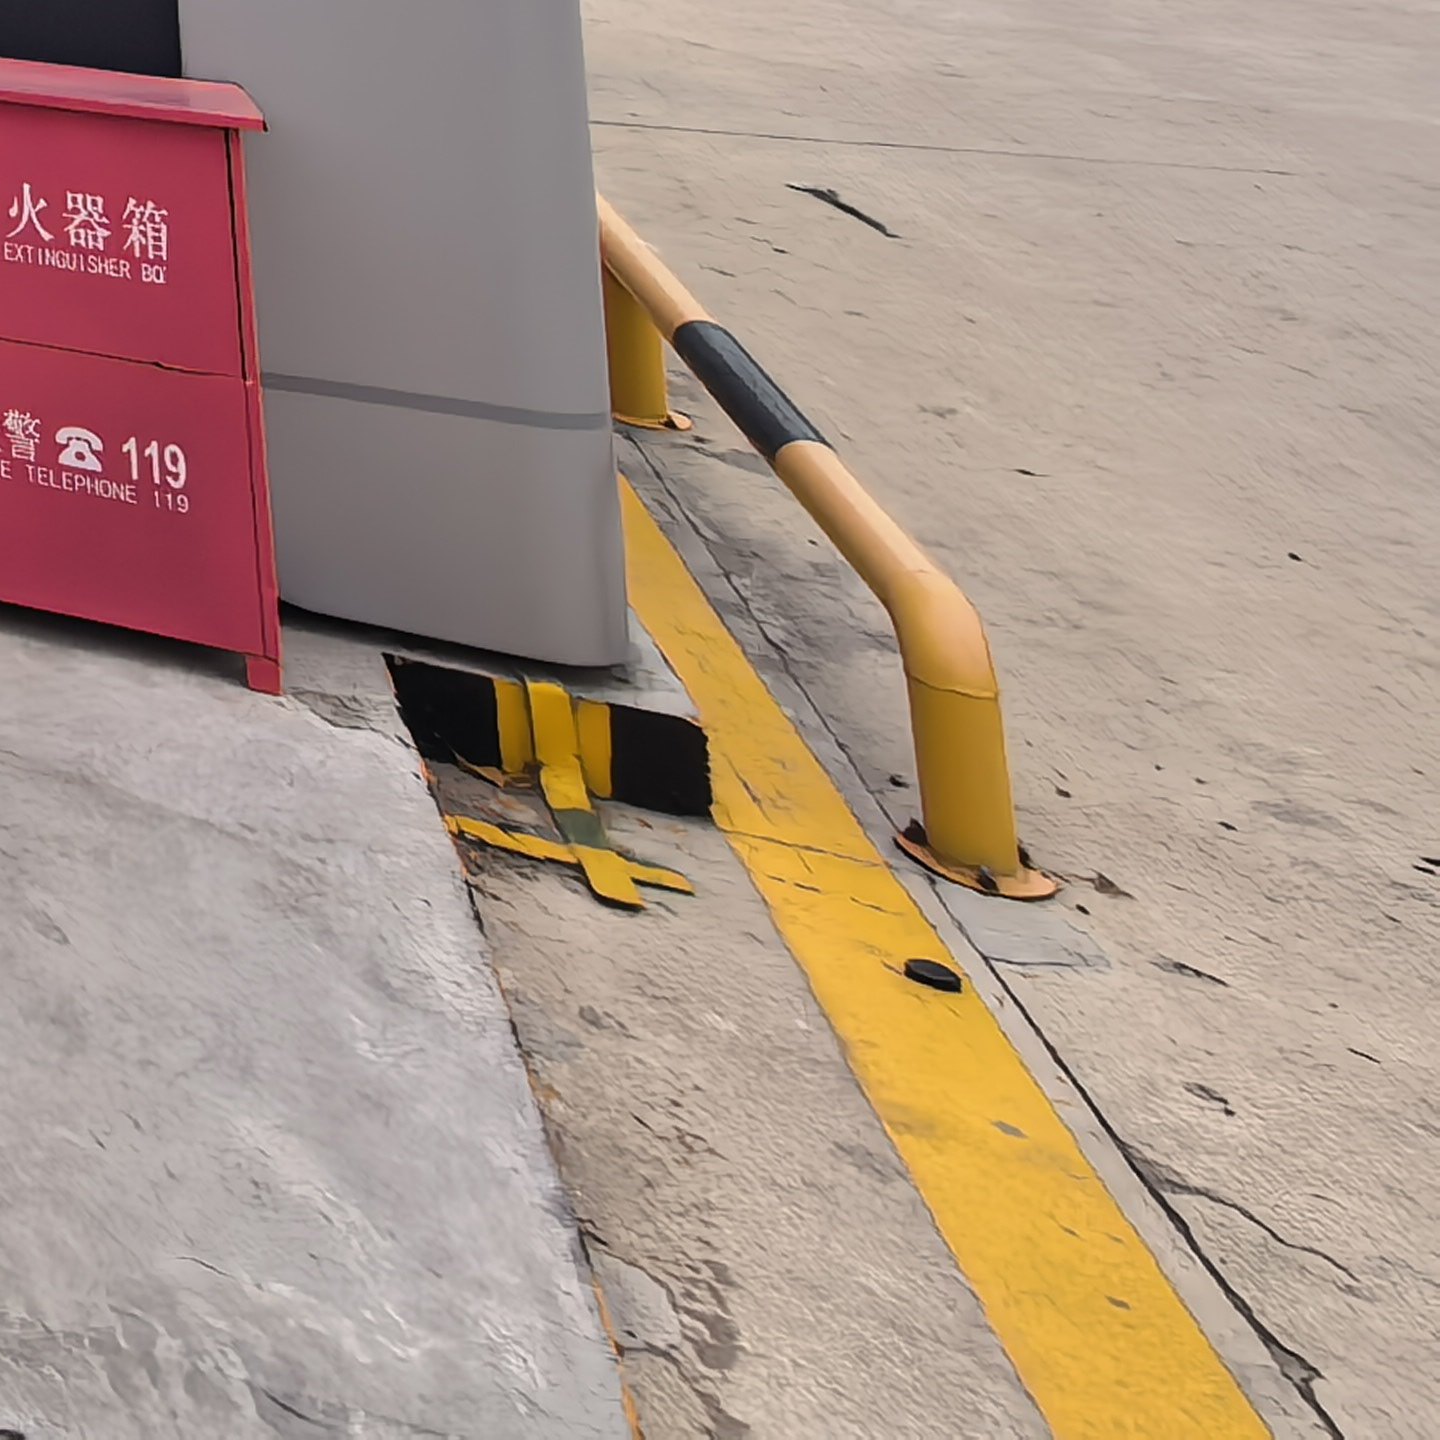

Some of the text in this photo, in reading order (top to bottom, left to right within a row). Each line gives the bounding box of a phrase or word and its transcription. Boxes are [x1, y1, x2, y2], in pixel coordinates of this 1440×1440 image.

[3, 241, 132, 280] EXTINGUISHER
[121, 436, 188, 490] 119
[25, 464, 138, 505] TELEPHONE
[153, 489, 190, 514] 119
